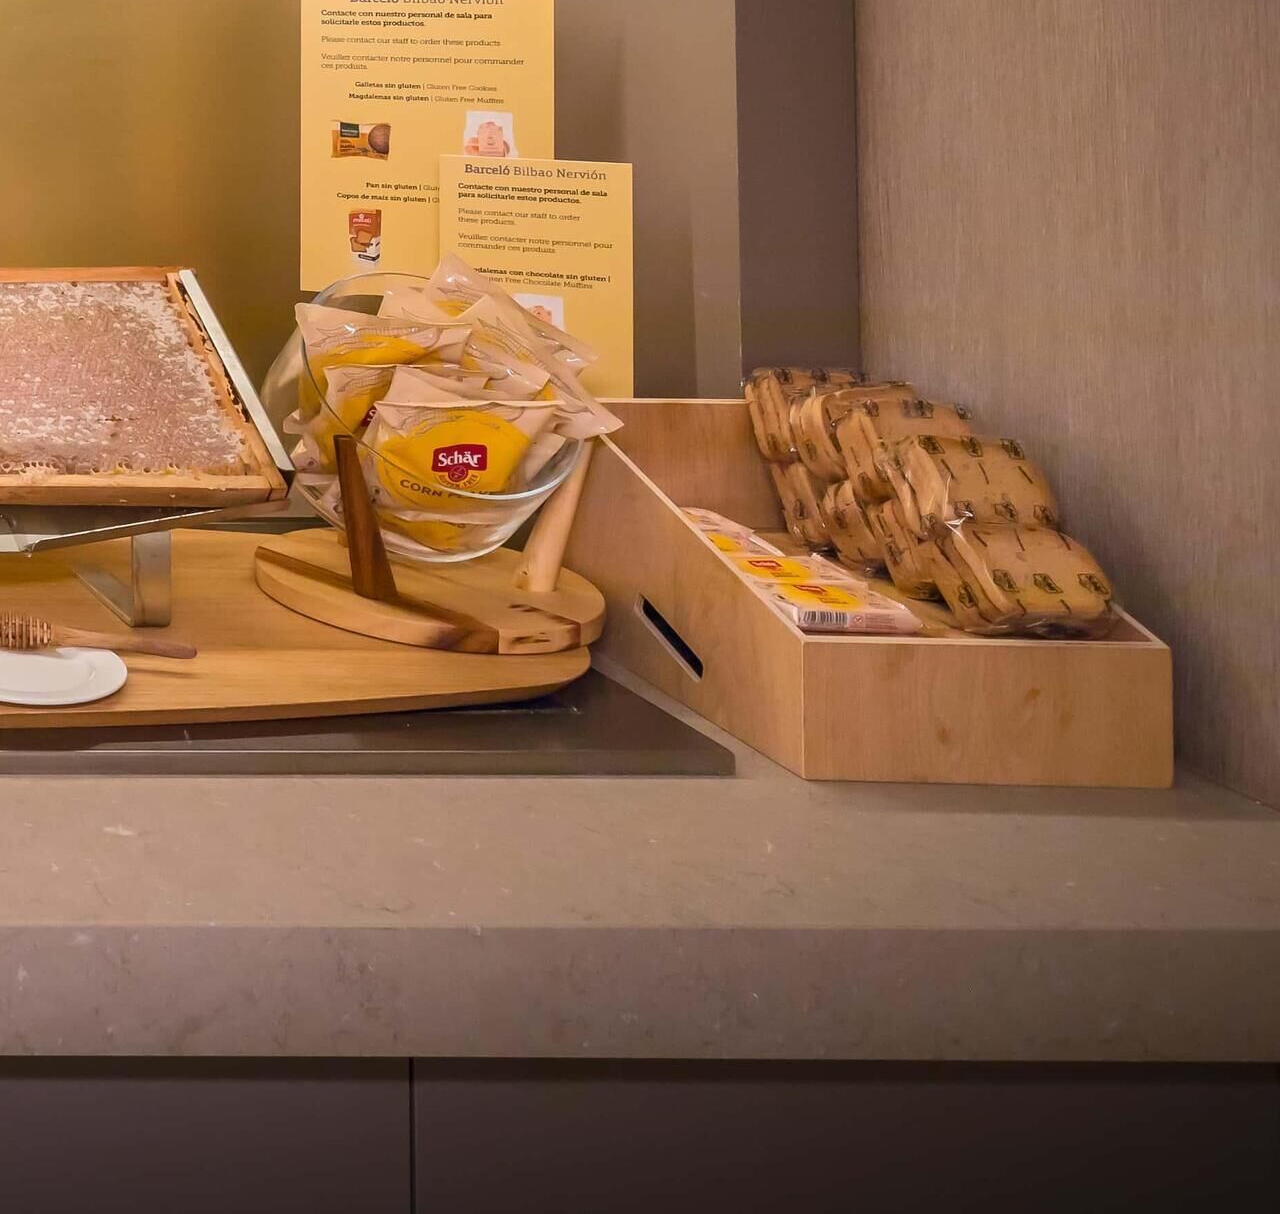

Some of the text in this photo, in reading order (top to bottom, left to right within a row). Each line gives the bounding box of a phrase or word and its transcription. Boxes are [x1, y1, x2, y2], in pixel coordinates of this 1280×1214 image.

[321, 9, 357, 17] Contacte
[321, 18, 360, 26] solicitarle
[321, 35, 346, 43] Please
[346, 36, 376, 44] contact
[442, 38, 464, 46] these
[321, 53, 351, 61] Veuillez
[351, 54, 389, 62] contacter
[474, 58, 524, 66] commander
[397, 82, 421, 90] gluten
[348, 92, 391, 101] Magdalenas
[405, 94, 429, 102] gluten
[459, 96, 476, 104] Free
[464, 163, 607, 181] Barceló Bilbao Nervión
[393, 183, 418, 191] gluten
[458, 182, 493, 191] Contacte
[511, 185, 542, 194] nuestro
[543, 187, 579, 196] personal
[336, 192, 359, 200] Copos
[477, 192, 515, 201] solicitarle
[538, 195, 582, 204] productos.
[458, 207, 482, 216] Please
[483, 210, 513, 218] contact
[458, 216, 479, 224] these
[458, 233, 614, 250] Veuillez contacter notre personnel pour
[458, 242, 506, 251] commander
[473, 267, 507, 276] dalenas
[525, 269, 565, 280] chocolate
[579, 274, 606, 283] gluten
[505, 276, 521, 285] Free
[522, 277, 561, 287] Chocolate
[562, 280, 593, 290] Muffins
[437, 450, 482, 468] Schär
[399, 478, 443, 498] CORN
